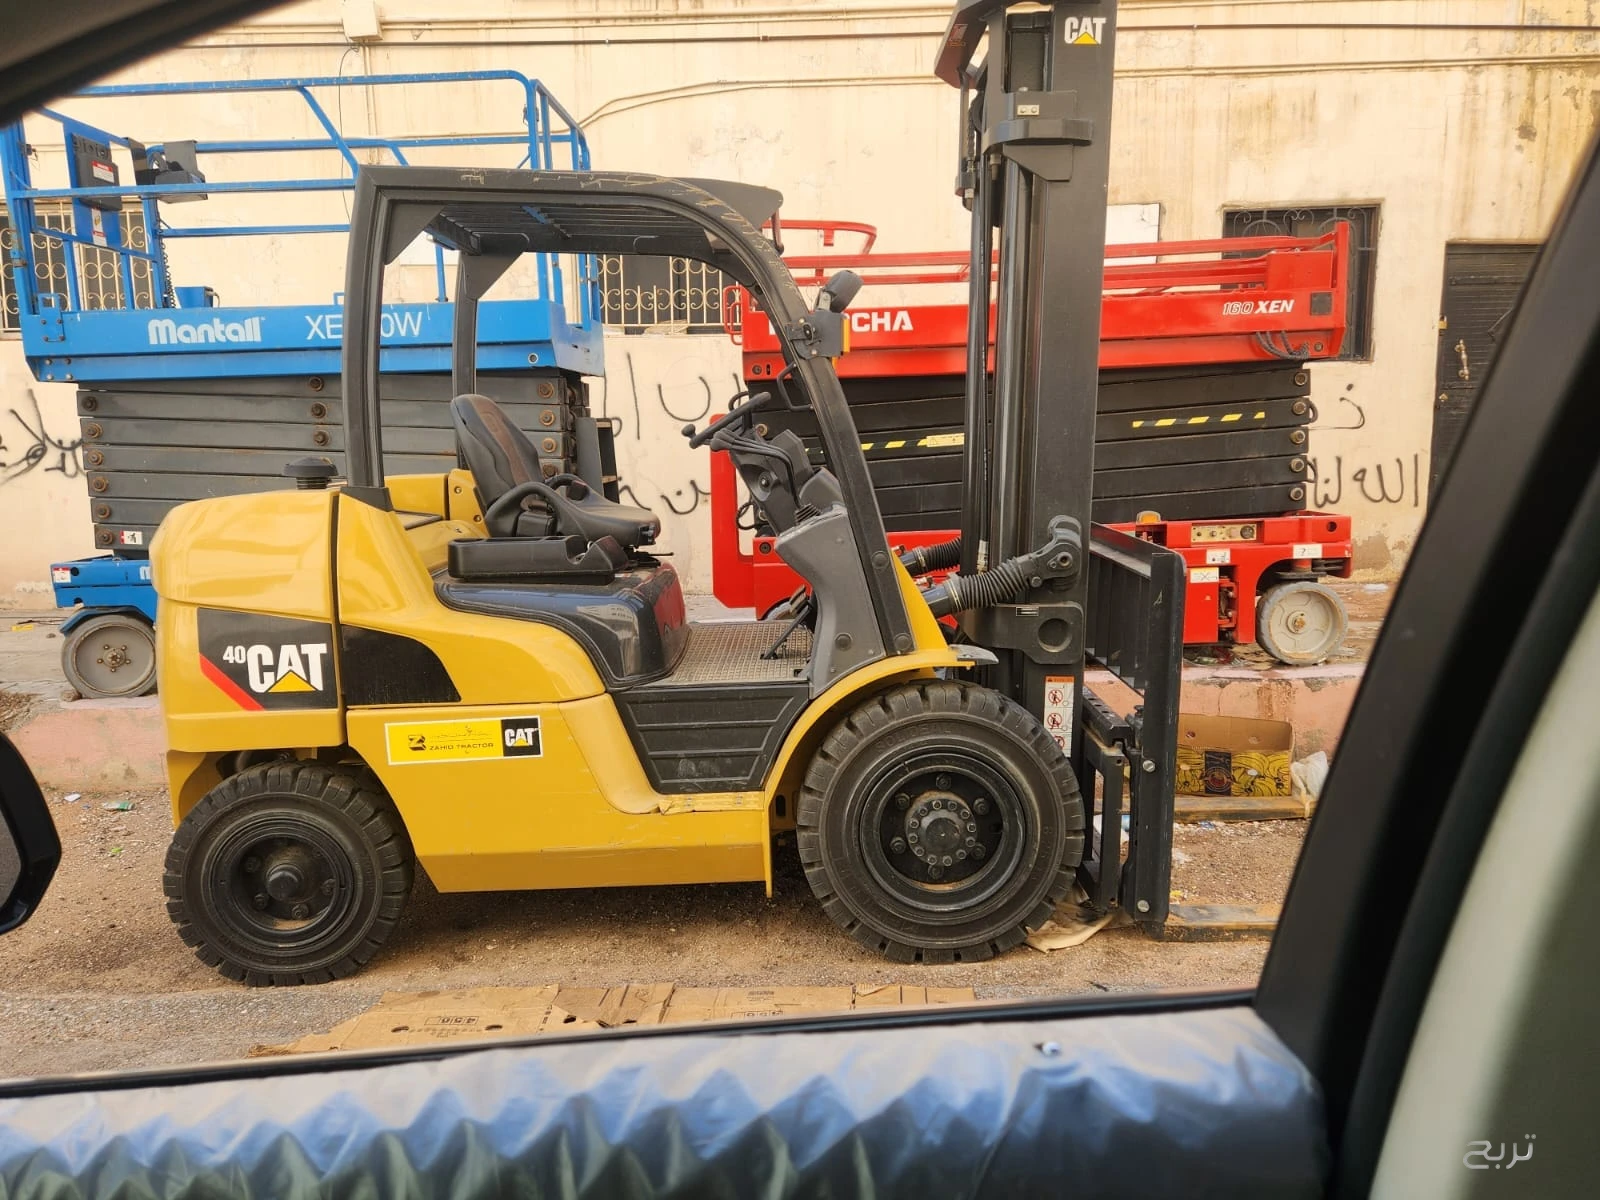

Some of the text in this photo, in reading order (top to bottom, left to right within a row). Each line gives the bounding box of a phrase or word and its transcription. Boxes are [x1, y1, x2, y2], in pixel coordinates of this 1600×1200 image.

[1064, 16, 1107, 45] CAT
[1254, 299, 1295, 314] XEN
[222, 643, 328, 693] 40 CAT
[504, 727, 536, 747] CAT
